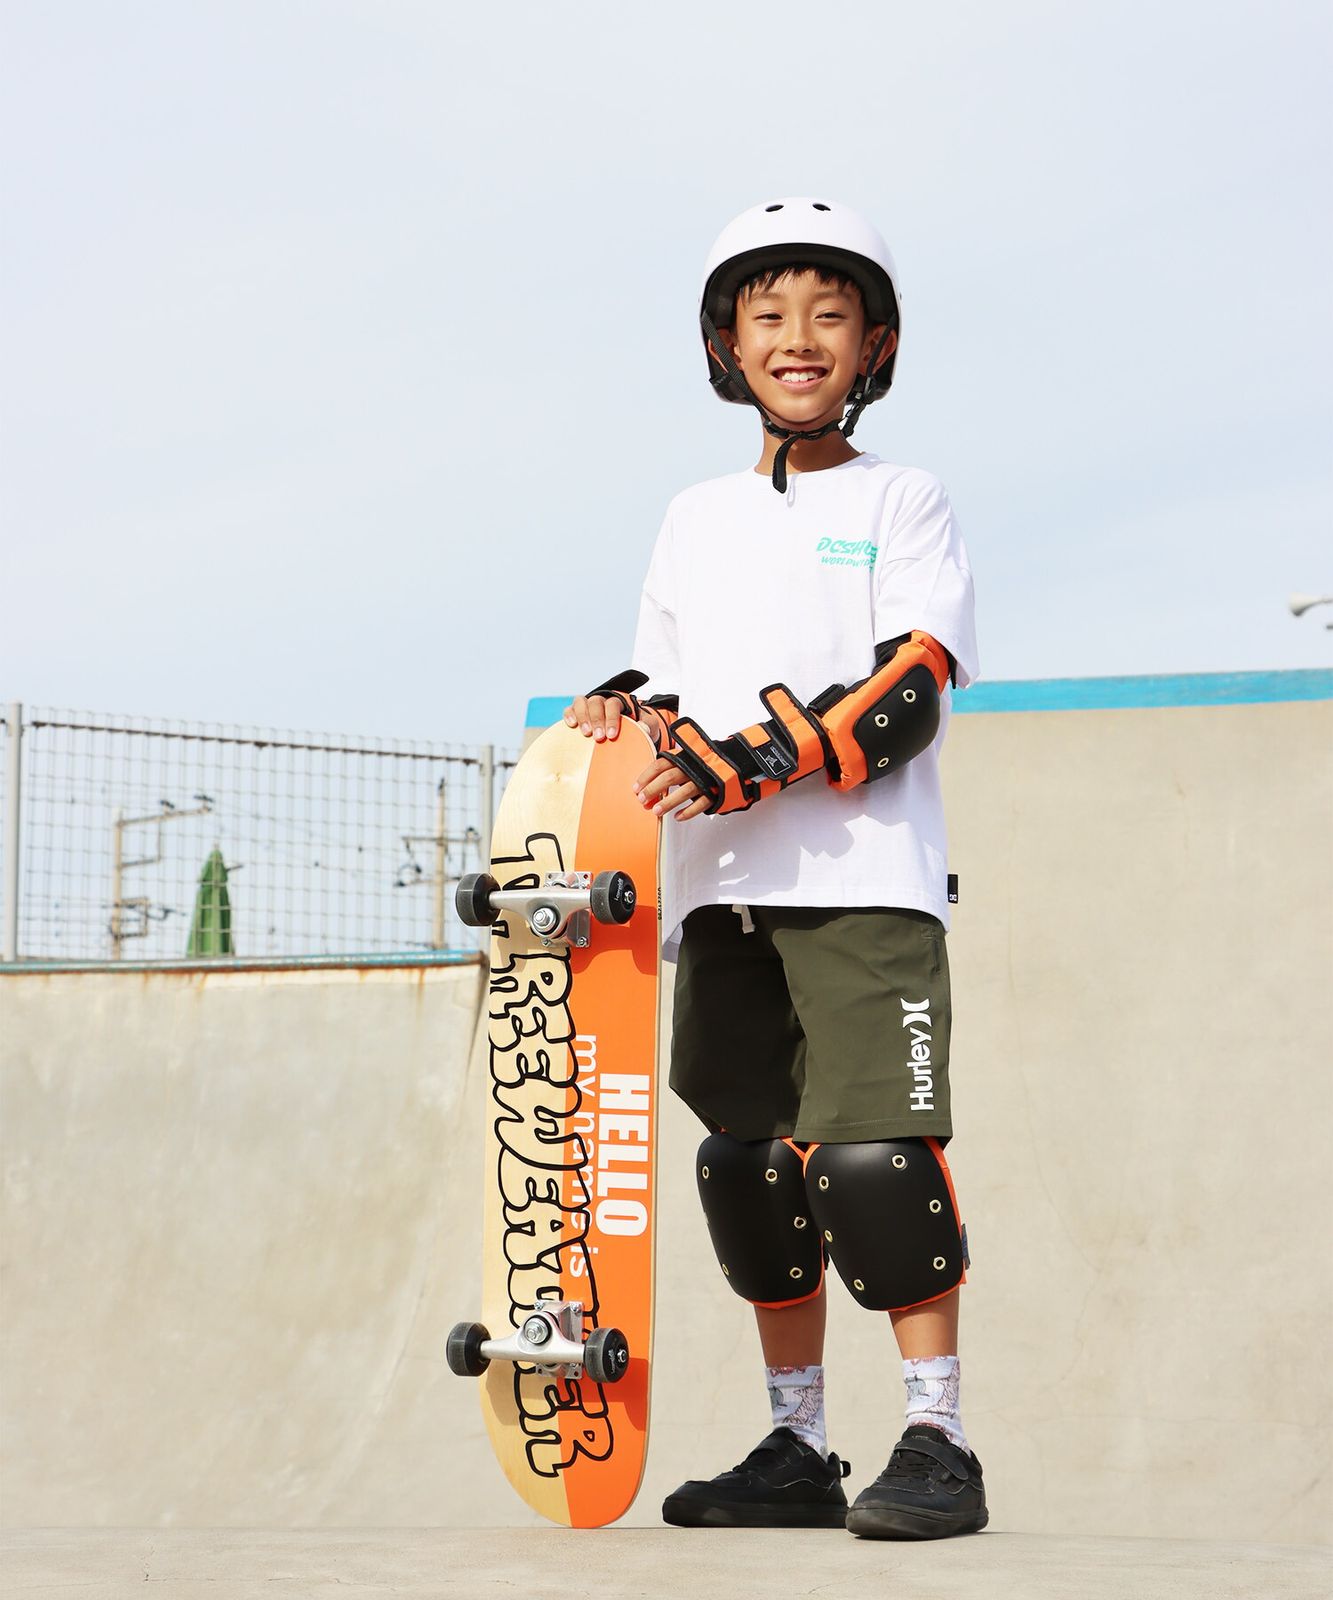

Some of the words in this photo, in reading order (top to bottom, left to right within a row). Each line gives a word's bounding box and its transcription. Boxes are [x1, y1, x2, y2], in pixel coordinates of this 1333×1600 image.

[821, 556, 875, 568] WORLDWID
[569, 1034, 597, 1097] my
[907, 1027, 935, 1111] Hurley
[571, 1113, 595, 1229] name
[597, 1074, 649, 1235] HELLO
[569, 1245, 599, 1278] is
